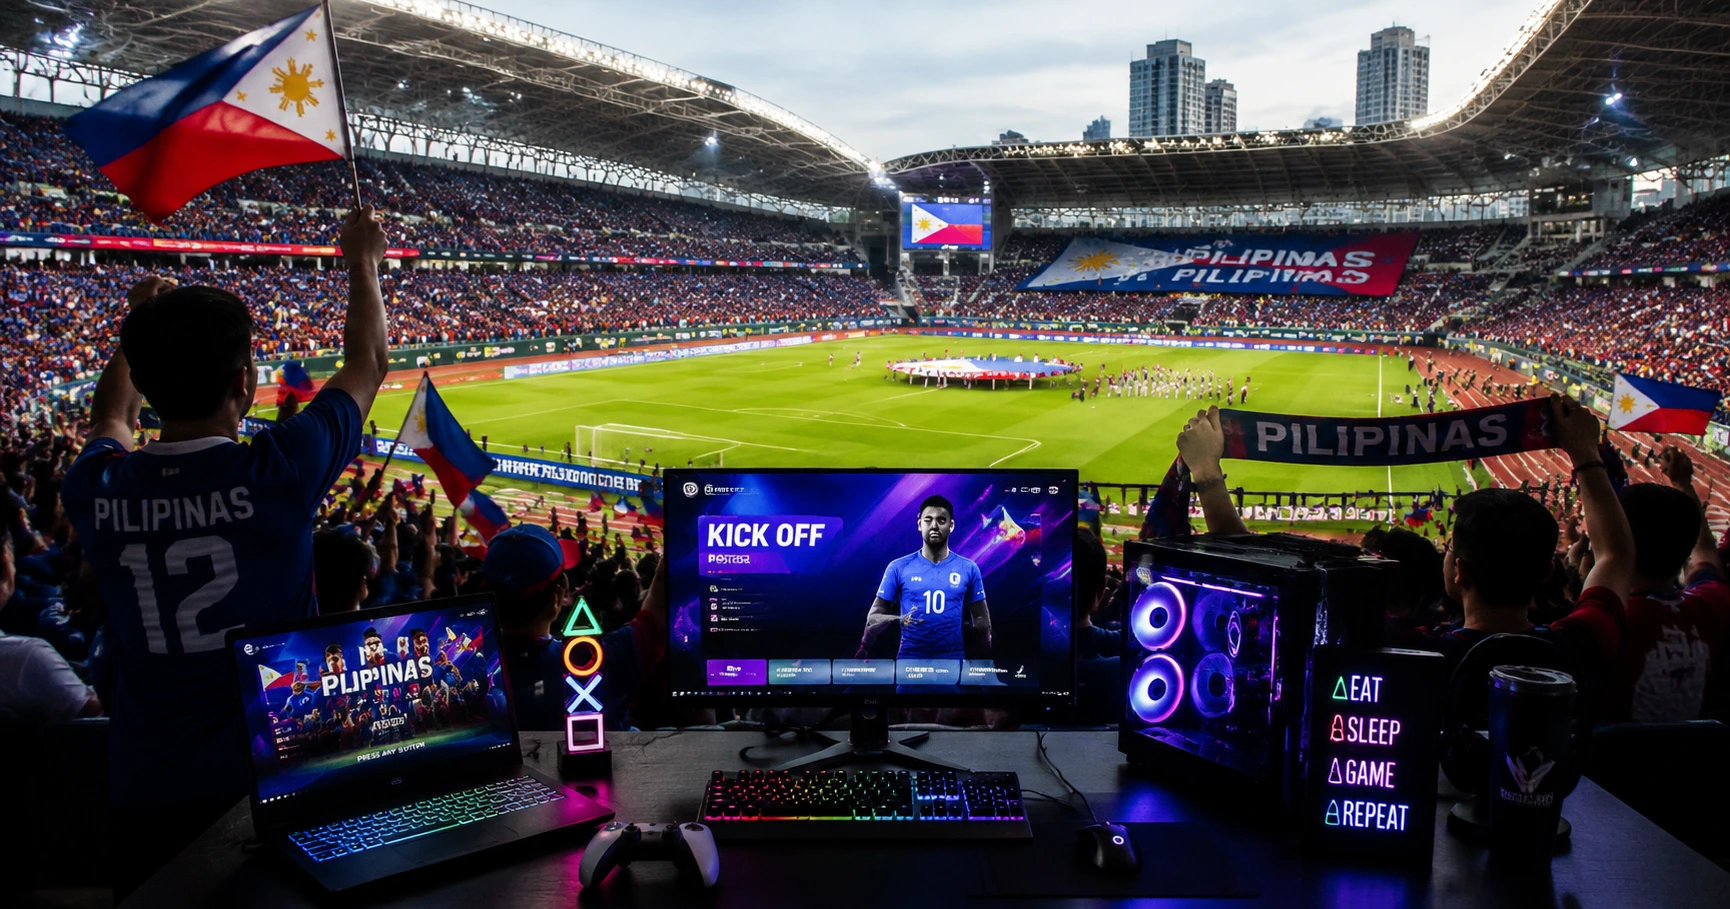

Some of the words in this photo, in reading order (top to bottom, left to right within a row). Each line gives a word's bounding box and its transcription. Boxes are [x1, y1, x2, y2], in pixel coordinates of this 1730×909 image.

[1256, 414, 1508, 456] PILIPINAS
[94, 486, 254, 532] PILIPINAS
[707, 523, 770, 547] KICK
[776, 523, 826, 547] OFF
[119, 535, 246, 654] 12
[923, 590, 945, 614] 10
[1350, 675, 1383, 703] EAT
[1347, 716, 1401, 746] SLEEP
[1346, 759, 1396, 789] GAME
[1343, 800, 1409, 831] REPEAT
